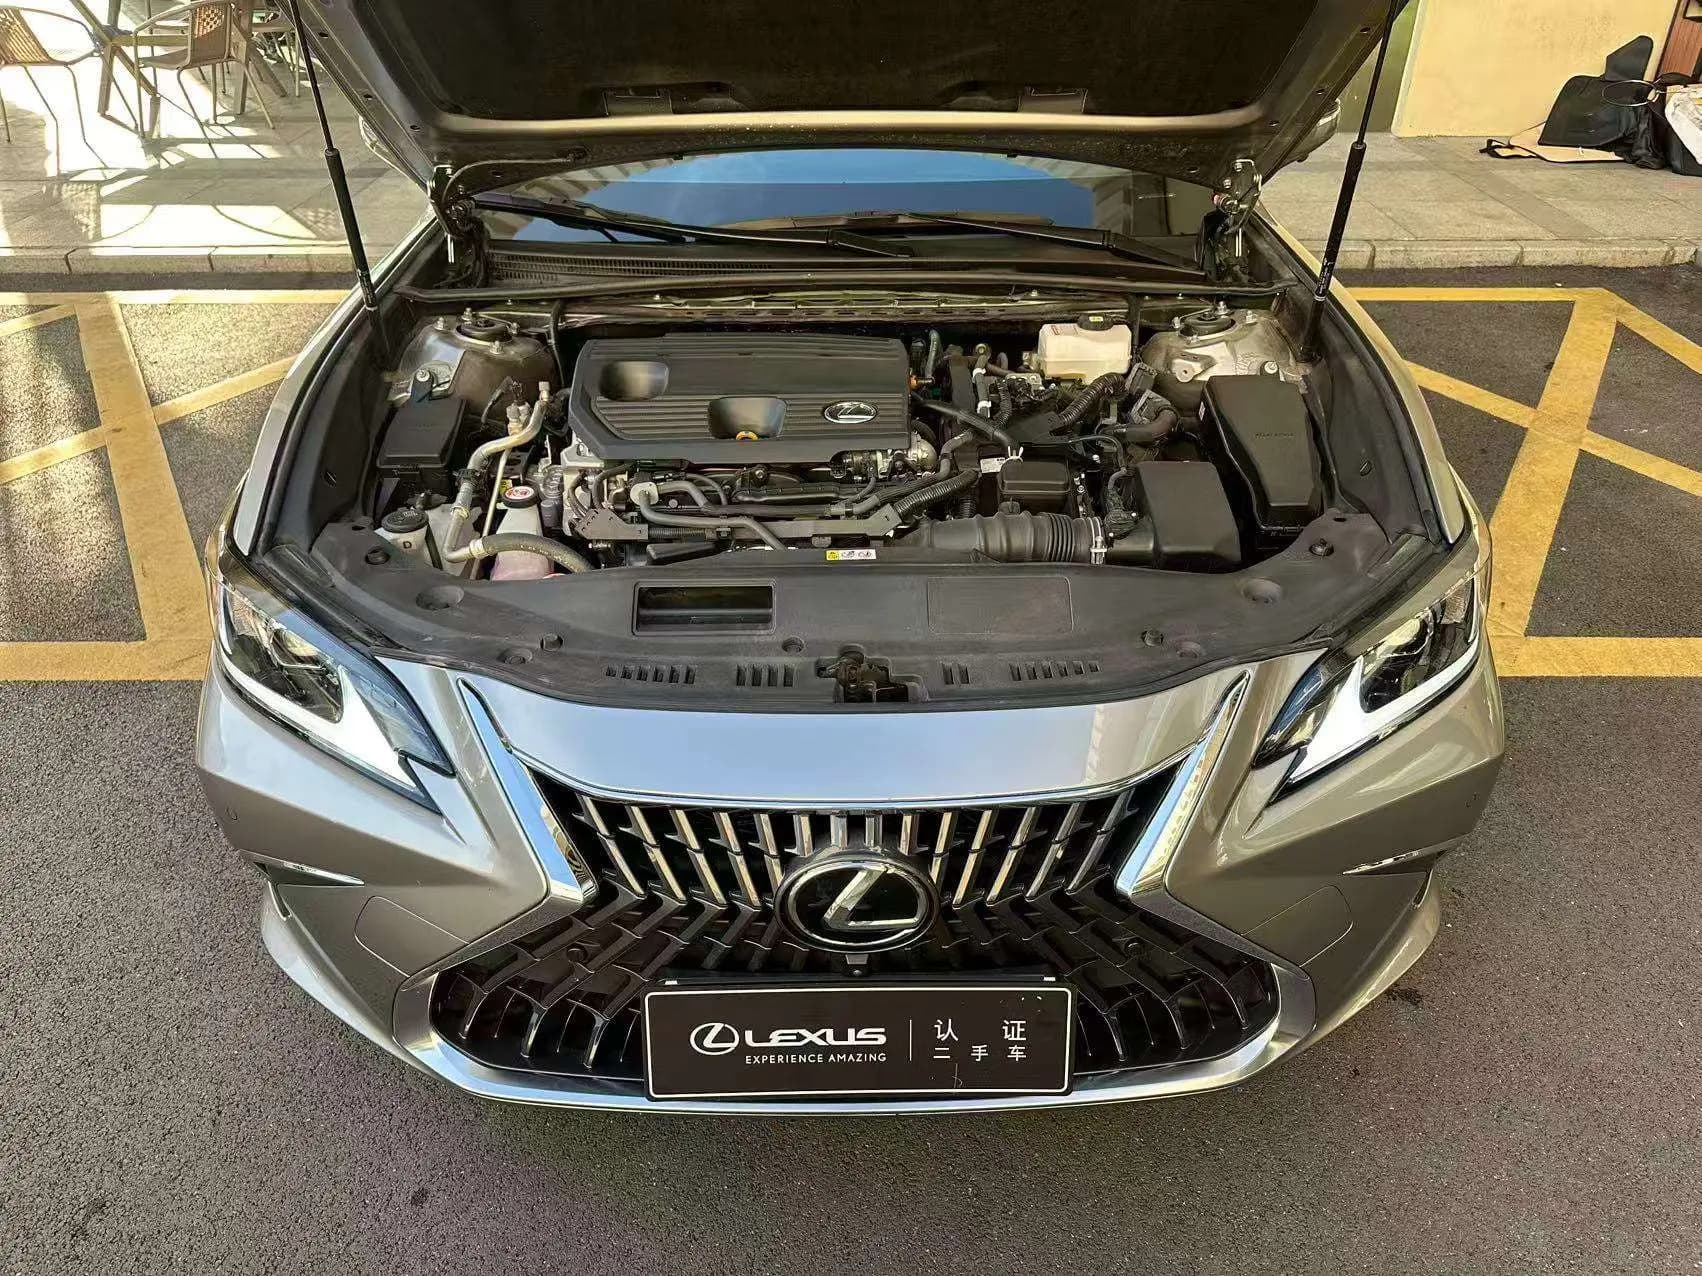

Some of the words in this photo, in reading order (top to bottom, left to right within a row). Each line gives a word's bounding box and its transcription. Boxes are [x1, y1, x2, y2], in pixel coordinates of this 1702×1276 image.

[745, 1027, 887, 1048] LEXUS
[933, 1018, 1027, 1041] 认证
[745, 1054, 824, 1065] EXPERIENCE
[828, 1052, 887, 1063] AMAZING
[933, 1044, 1027, 1062] 二手车
